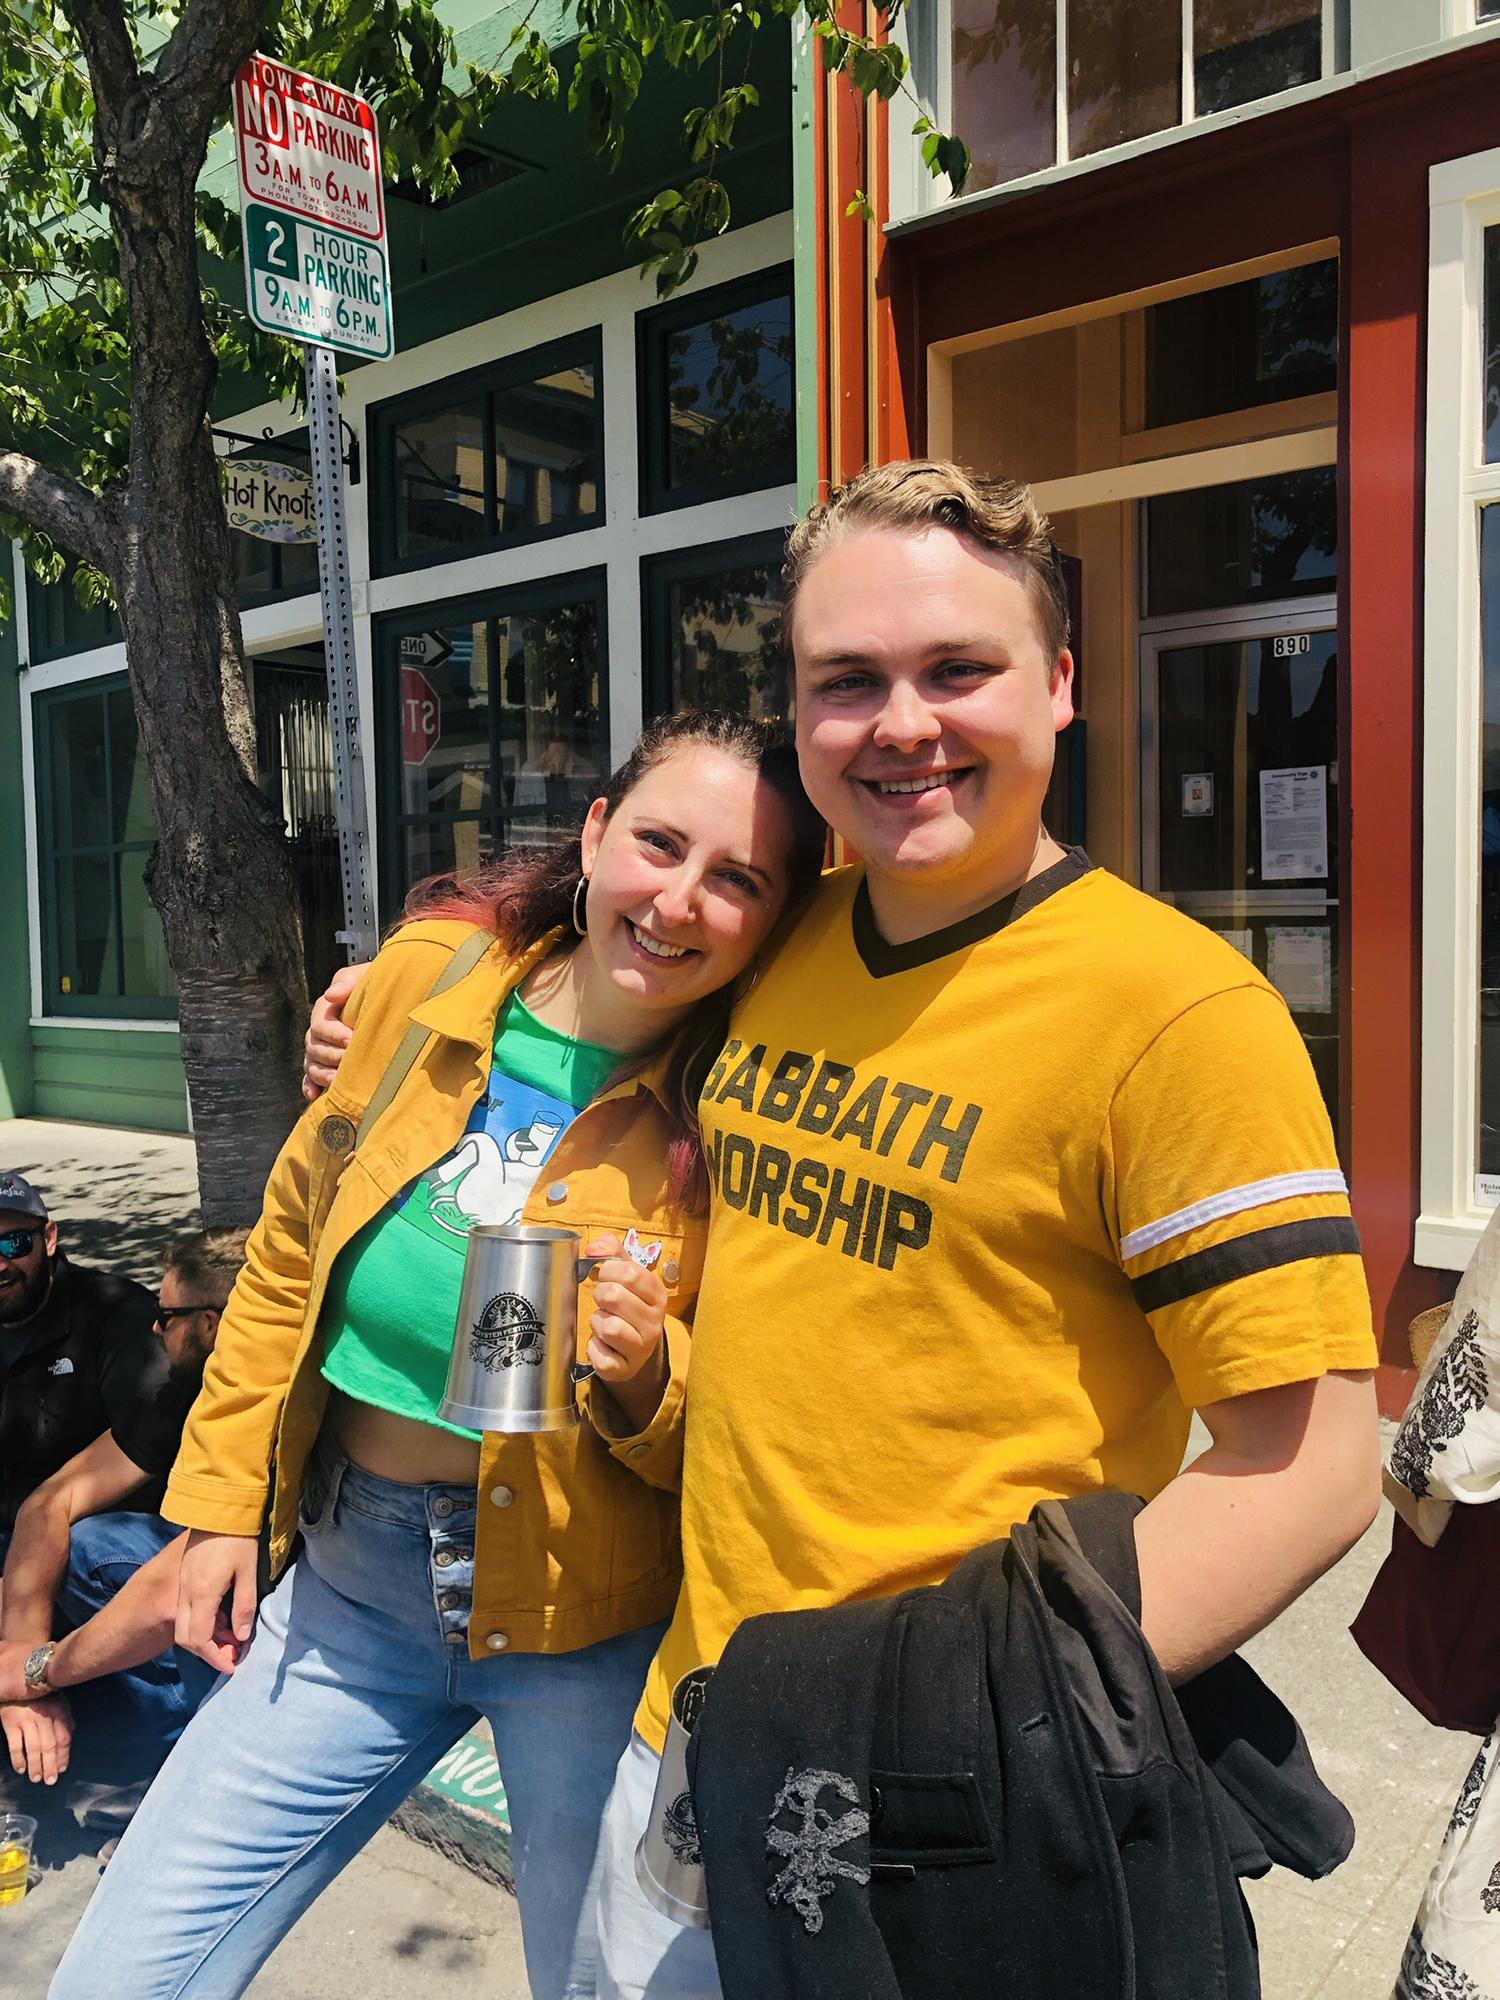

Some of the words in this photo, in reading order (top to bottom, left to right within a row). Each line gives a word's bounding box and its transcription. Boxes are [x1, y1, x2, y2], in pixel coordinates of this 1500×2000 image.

[242, 80, 284, 142] NO
[293, 111, 371, 171] PARKING
[260, 187, 296, 205] PHONE
[309, 176, 321, 191] TO
[271, 182, 291, 194] FOR
[297, 191, 329, 208] TOWED
[335, 203, 357, 218] CARS
[264, 220, 288, 268] 2
[312, 231, 369, 270] HOUR
[304, 253, 381, 306] PARKING
[276, 312, 316, 328] EXCEPT
[332, 328, 371, 344] SUNDAY
[319, 305, 331, 319] TO
[224, 476, 260, 510] Hot
[1275, 635, 1308, 656] 890
[701, 1039, 983, 1184] SABBATH
[488, 1298, 517, 1320] ARCATA
[517, 1303, 529, 1320] BAY
[476, 1330, 502, 1338] OYSTER
[504, 1324, 539, 1335] FESTIVAL
